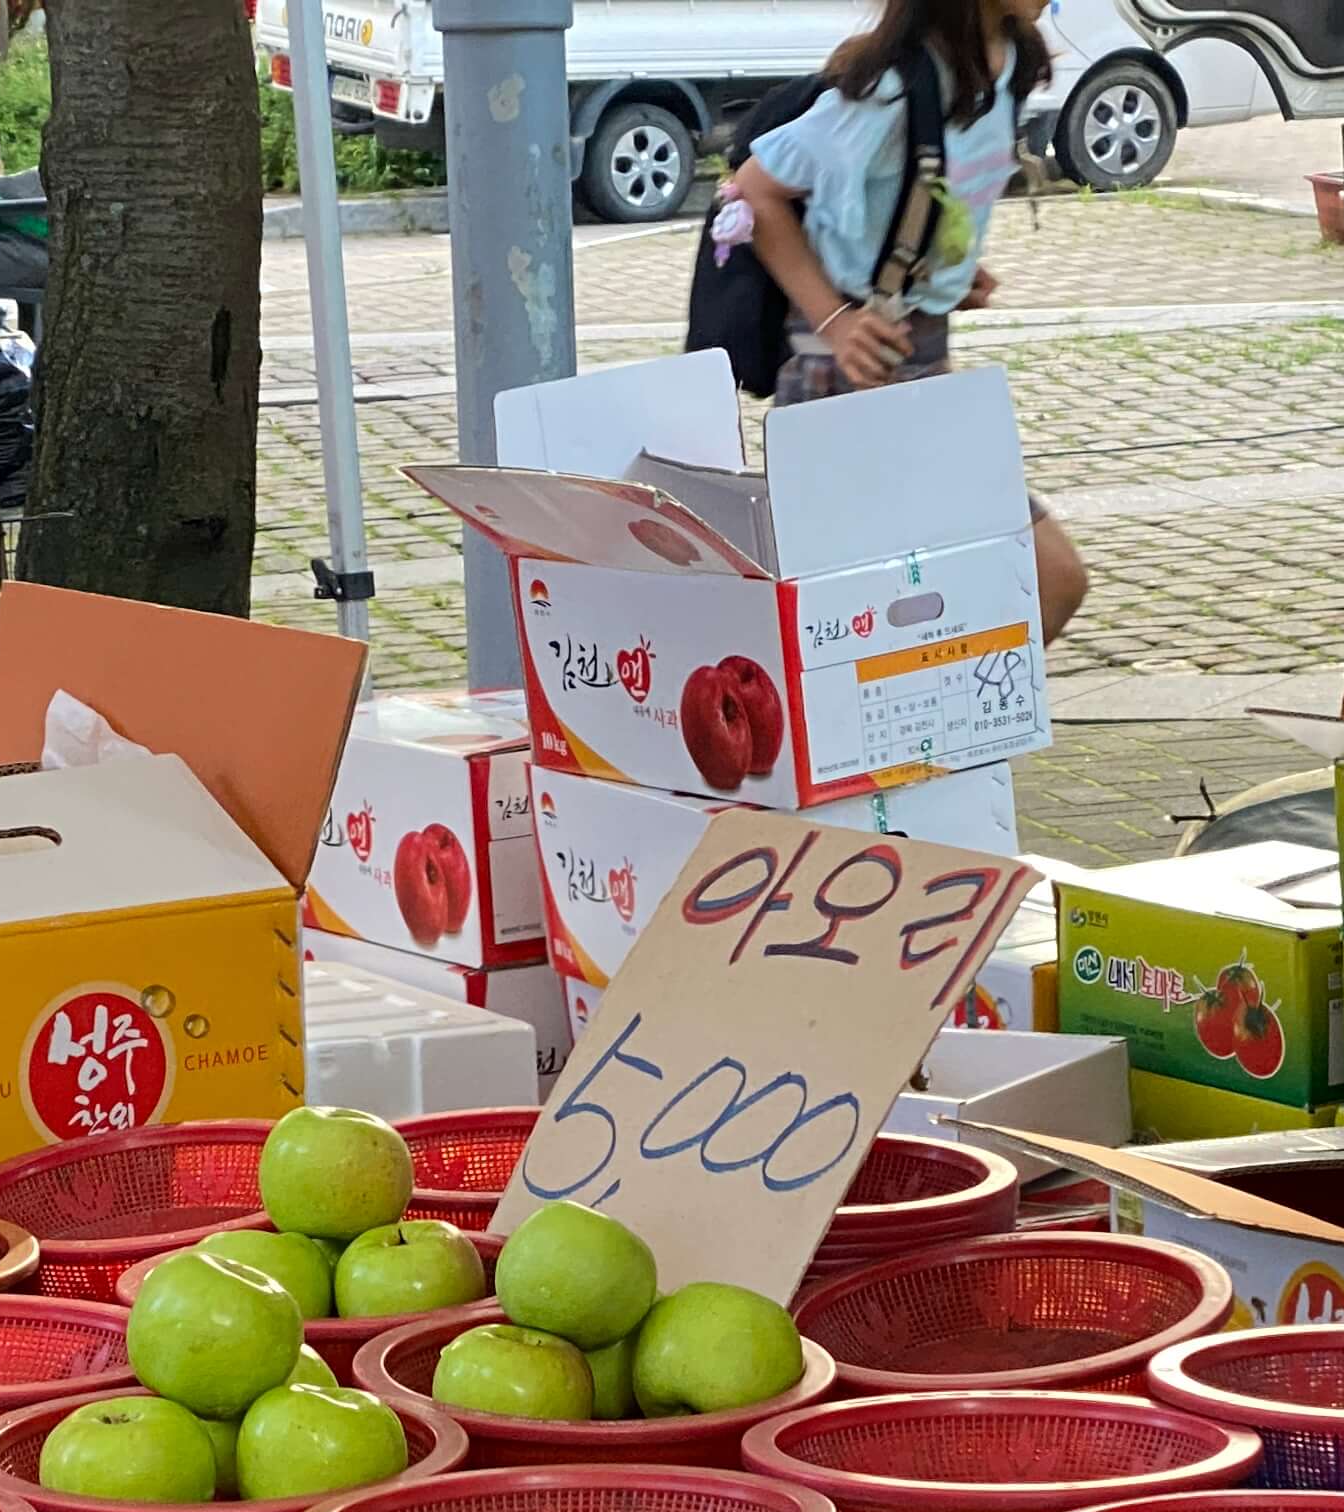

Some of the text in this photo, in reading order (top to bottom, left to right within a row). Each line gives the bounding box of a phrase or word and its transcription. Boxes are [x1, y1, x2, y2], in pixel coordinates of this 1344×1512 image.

[973, 648, 1022, 698] 48
[681, 829, 1030, 1011] 아오리
[47, 1003, 149, 1096] 성주
[183, 1043, 270, 1073] CHAMOE
[522, 1012, 859, 1208] 5,000
